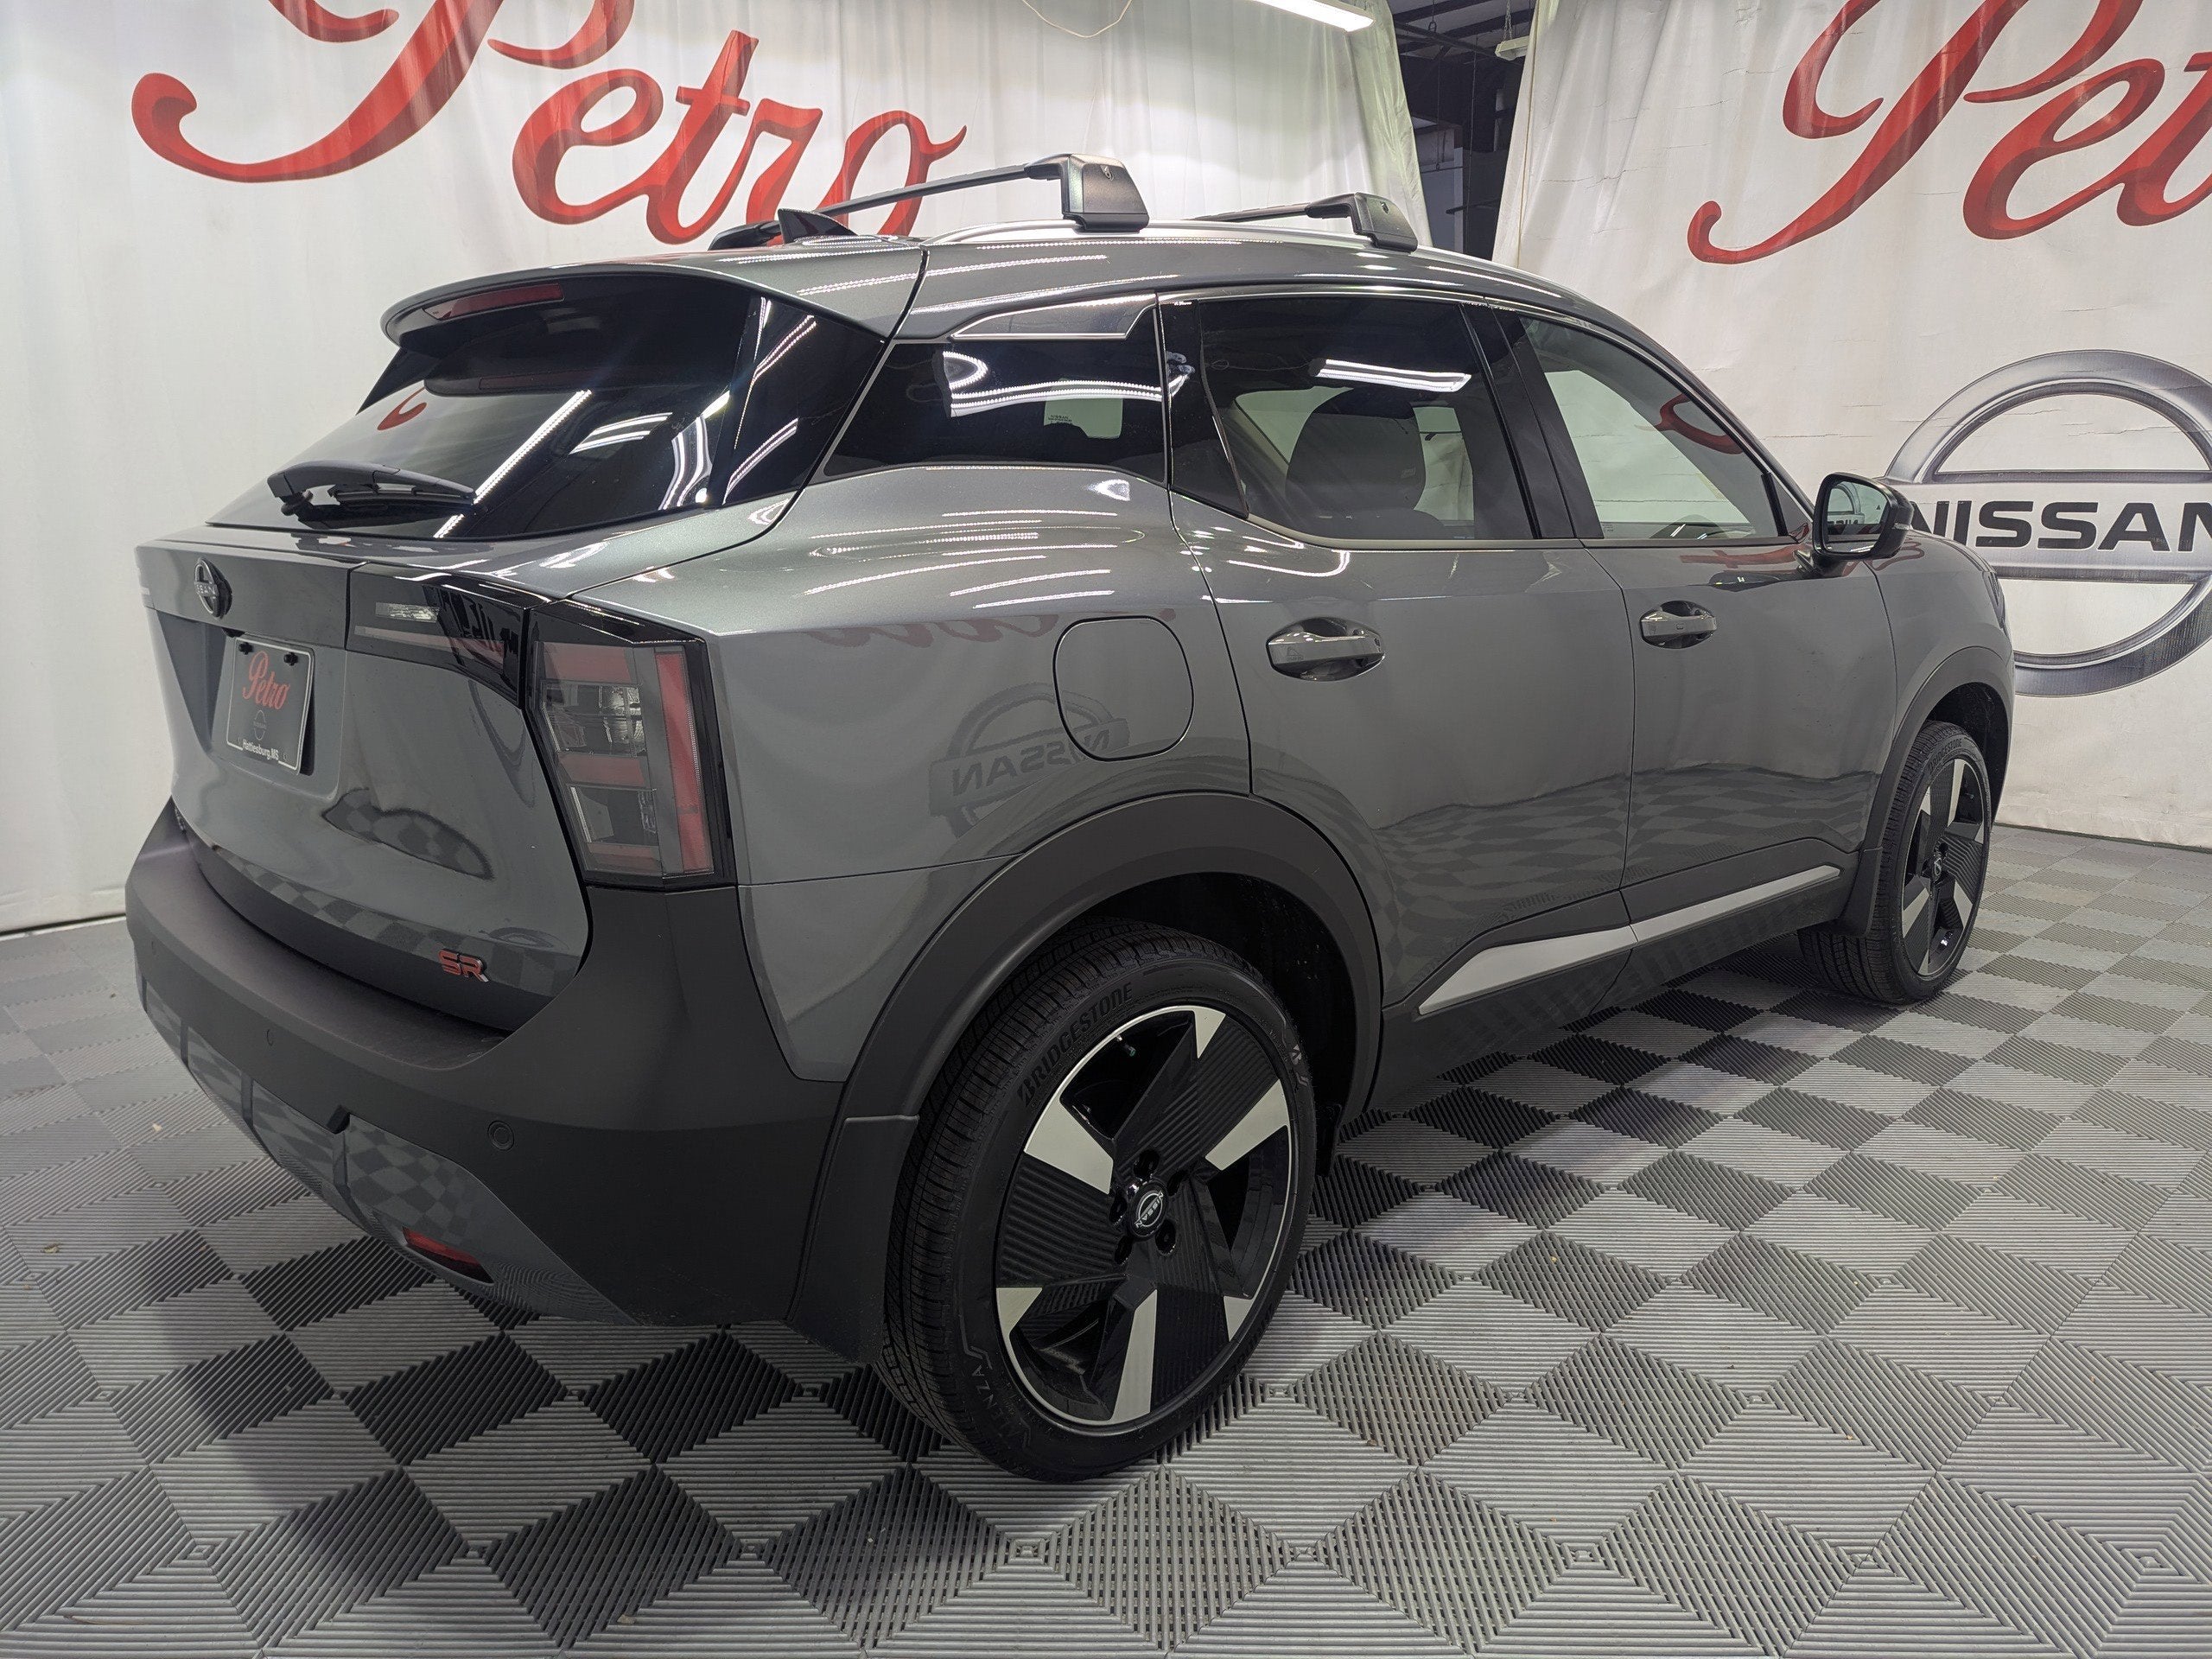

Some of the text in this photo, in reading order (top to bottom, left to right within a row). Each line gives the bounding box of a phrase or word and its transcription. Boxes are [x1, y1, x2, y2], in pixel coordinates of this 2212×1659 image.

[242, 651, 290, 710] Petro
[438, 950, 489, 982] SR
[1017, 982, 1133, 1107] BRIDGESTONE
[1135, 1191, 1164, 1229] NISSAN
